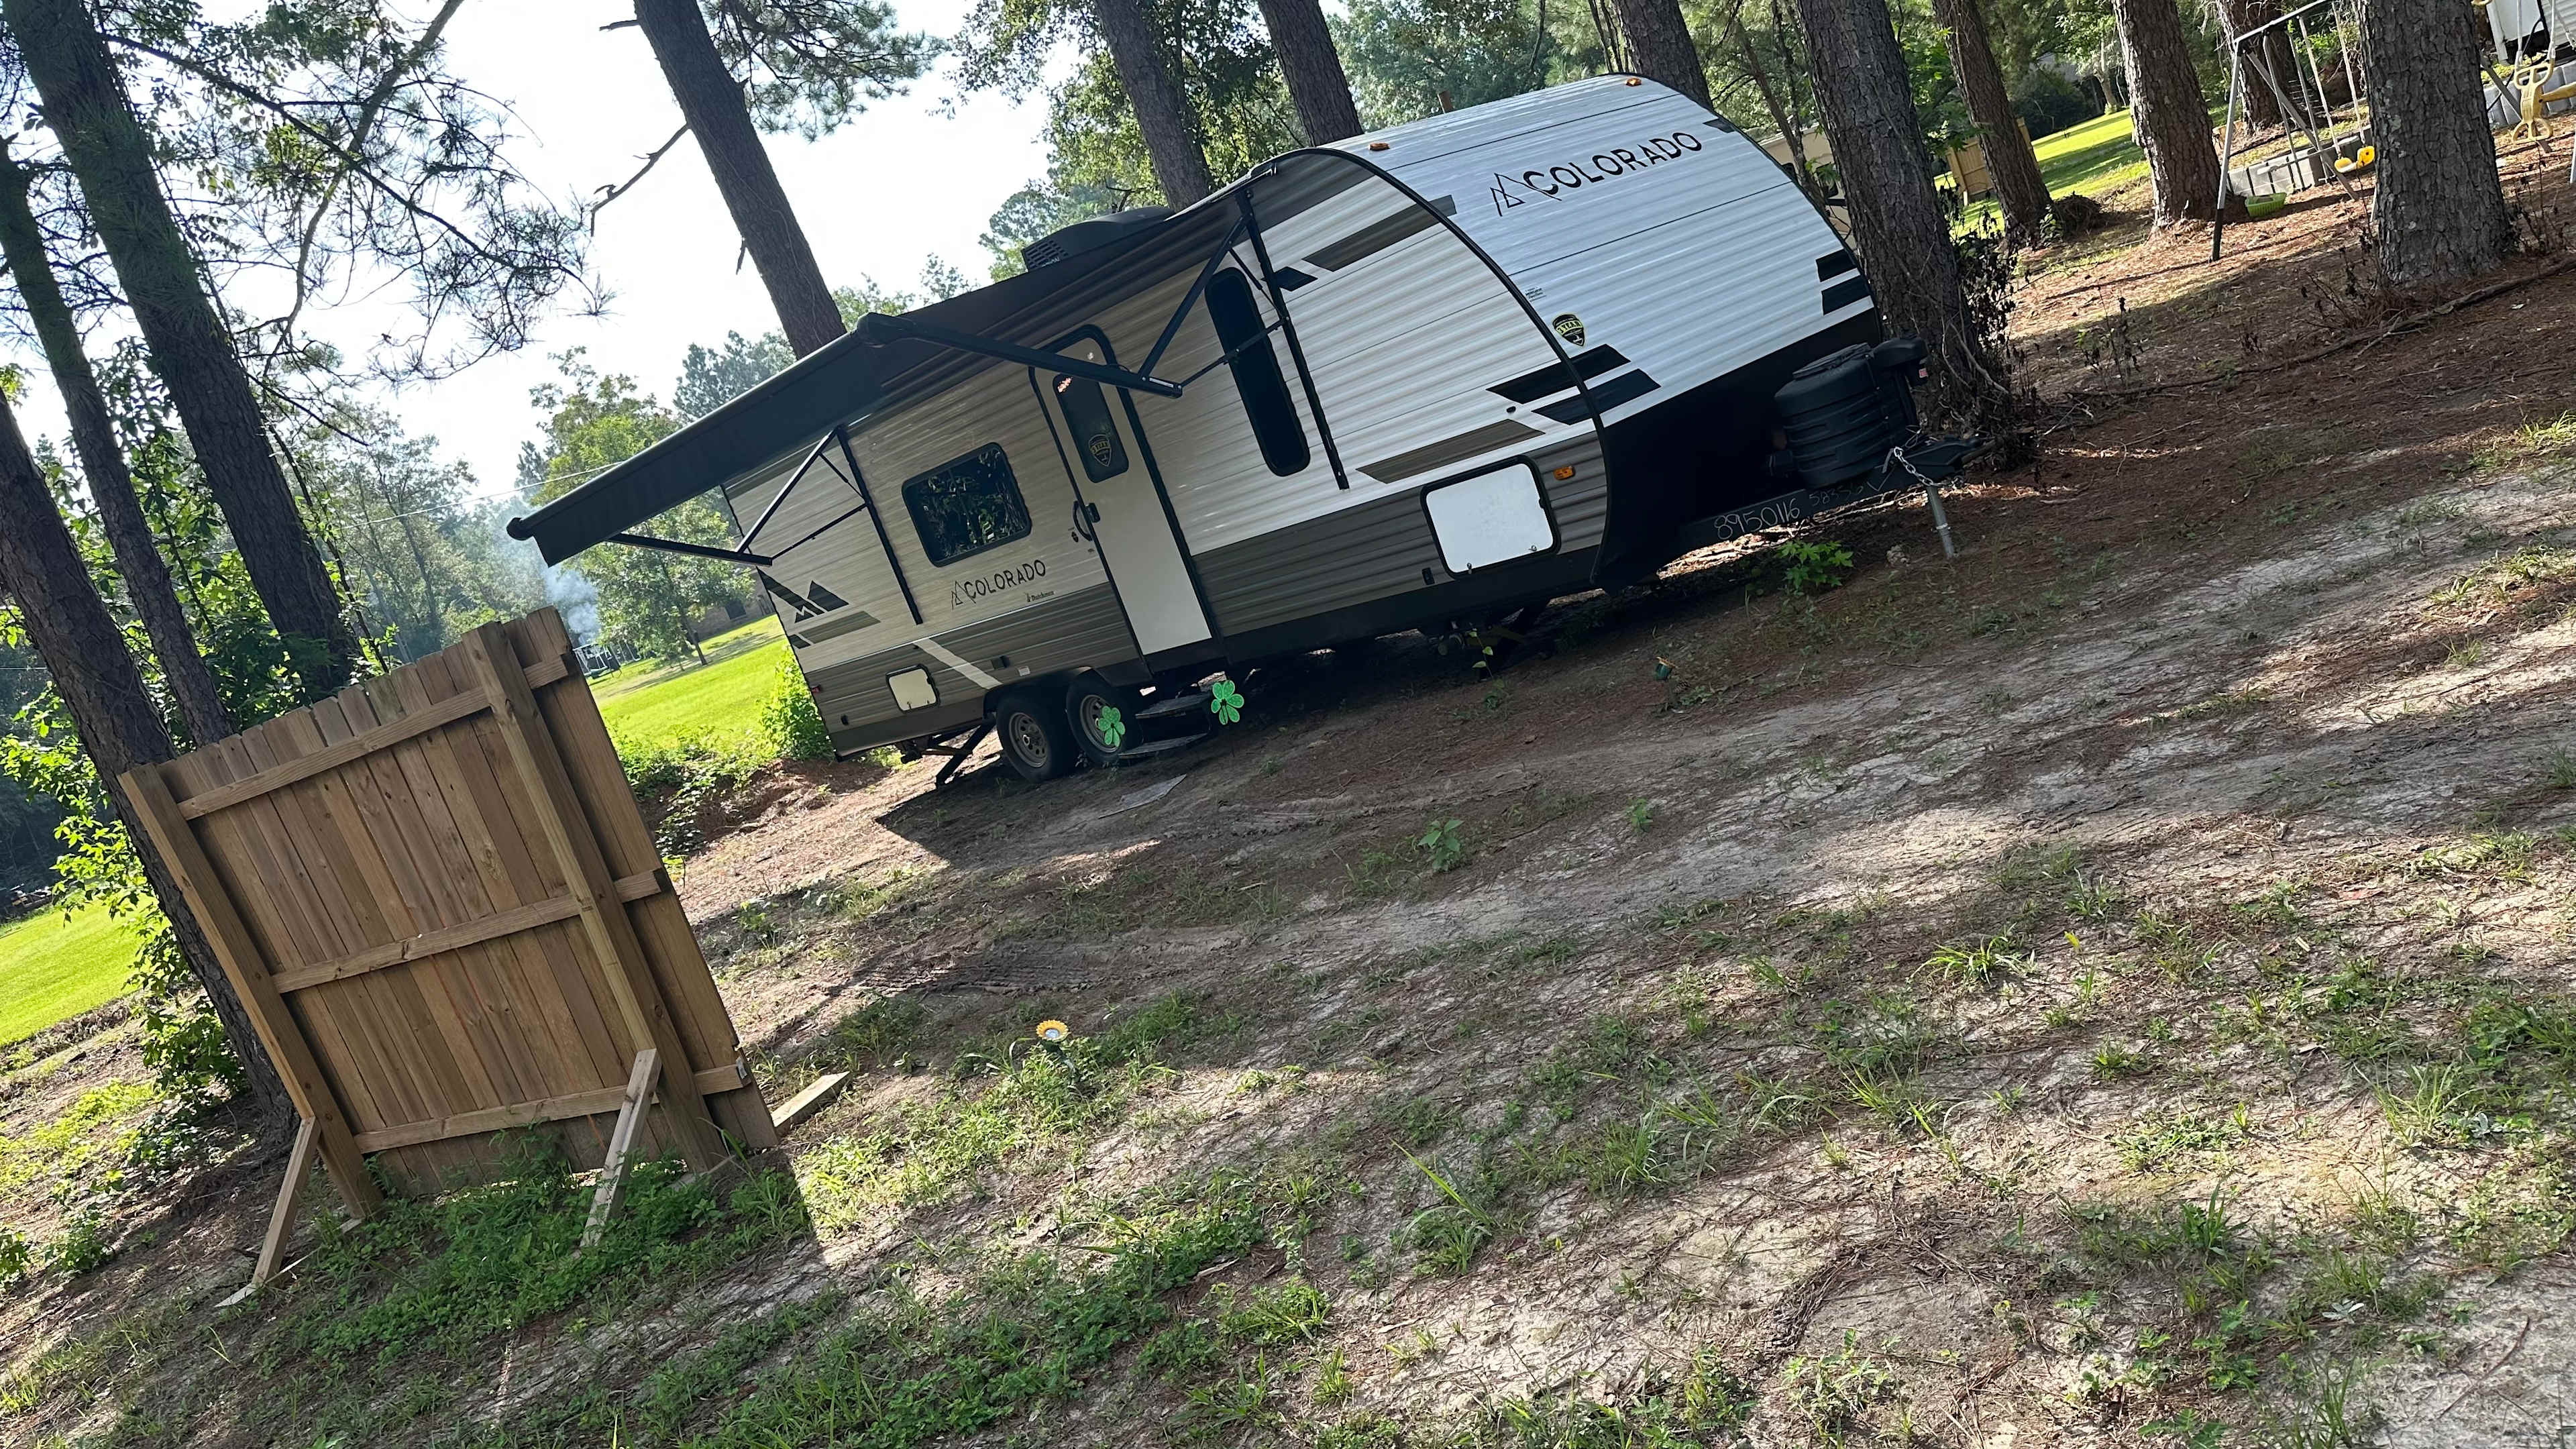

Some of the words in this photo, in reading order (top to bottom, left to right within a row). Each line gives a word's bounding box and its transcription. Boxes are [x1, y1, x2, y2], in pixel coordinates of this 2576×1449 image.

[1523, 132, 1702, 195] COLORADO
[1714, 498, 1800, 539] 8950116
[964, 559, 1046, 600] COLORADO
